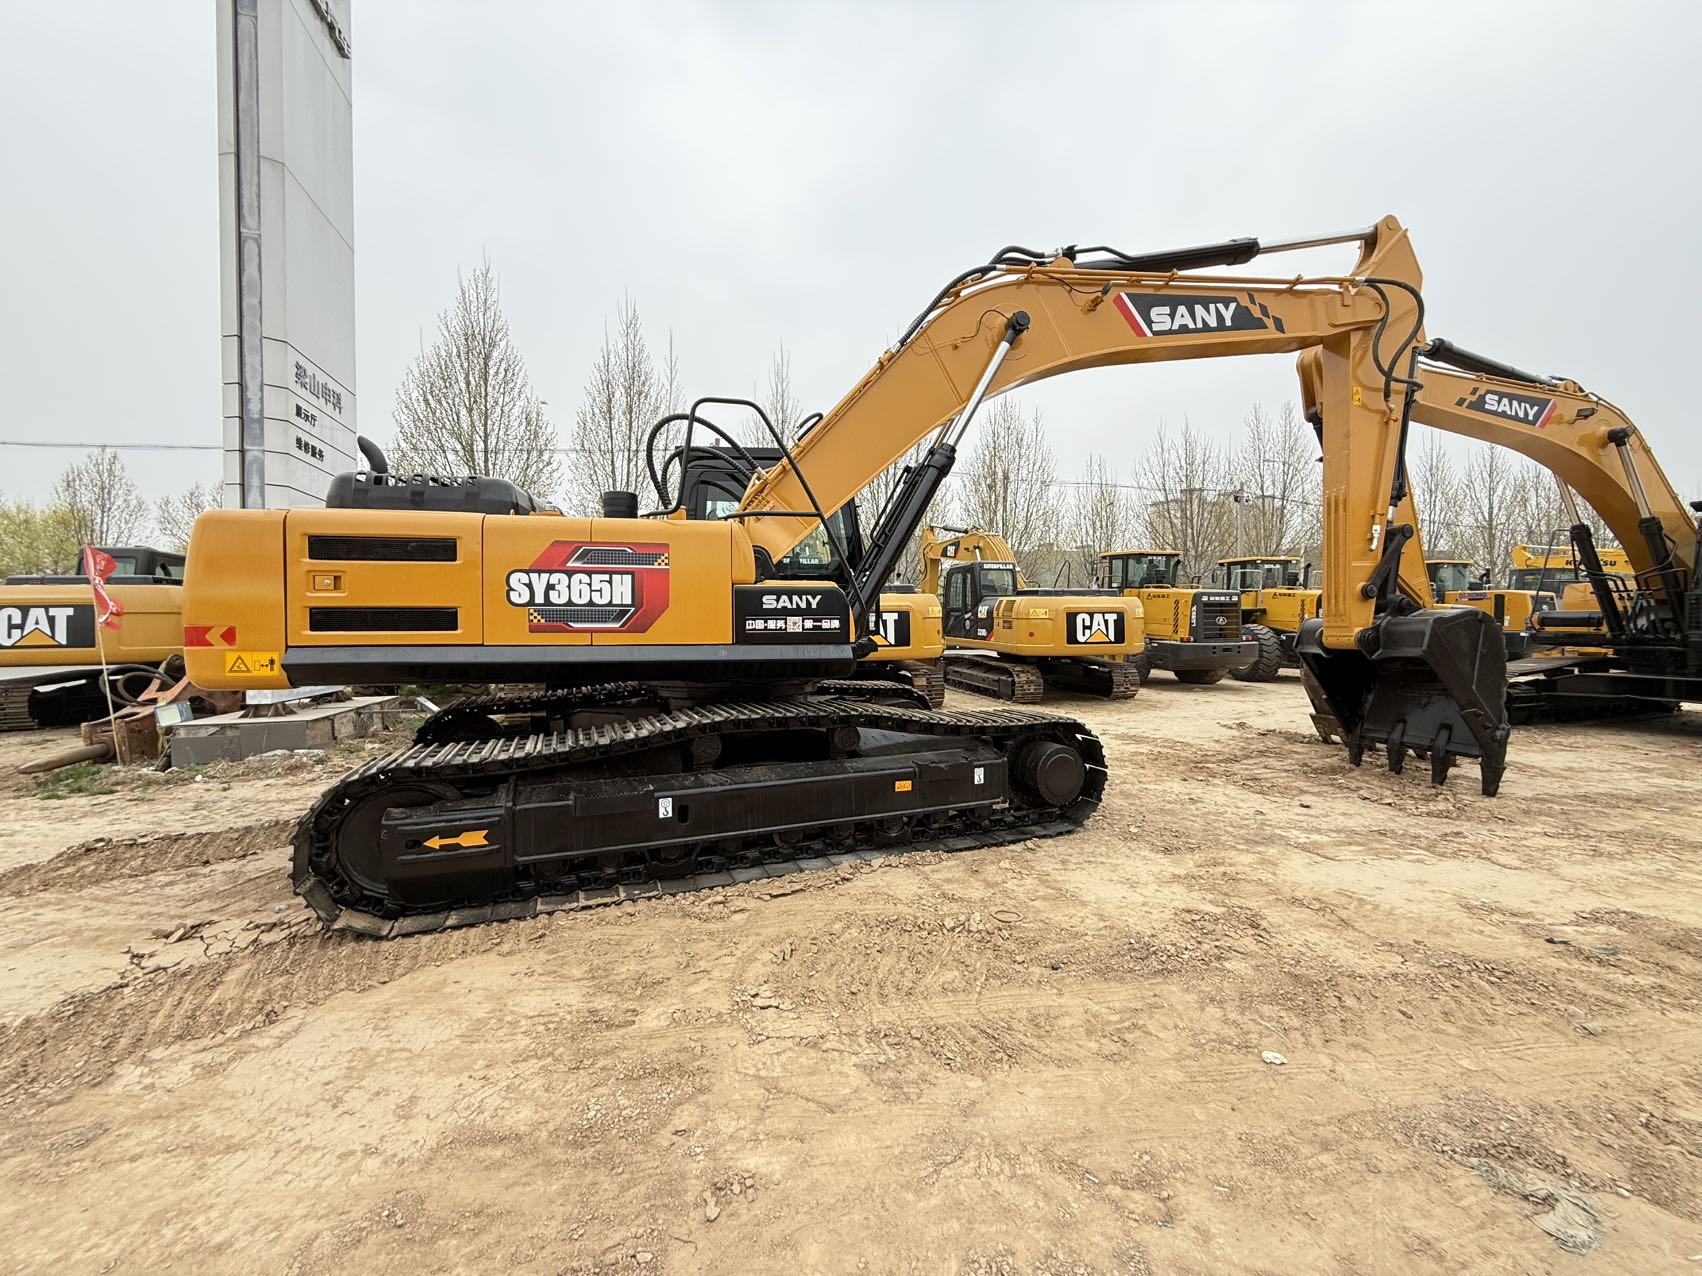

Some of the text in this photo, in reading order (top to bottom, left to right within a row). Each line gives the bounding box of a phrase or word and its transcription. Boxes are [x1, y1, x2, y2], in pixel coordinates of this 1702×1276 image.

[1150, 303, 1238, 331] SANY
[1484, 393, 1539, 421] SANY
[509, 572, 633, 605] SY365H
[761, 594, 822, 609] SANY
[0, 607, 74, 647] CAT
[1076, 612, 1117, 643] CAT
